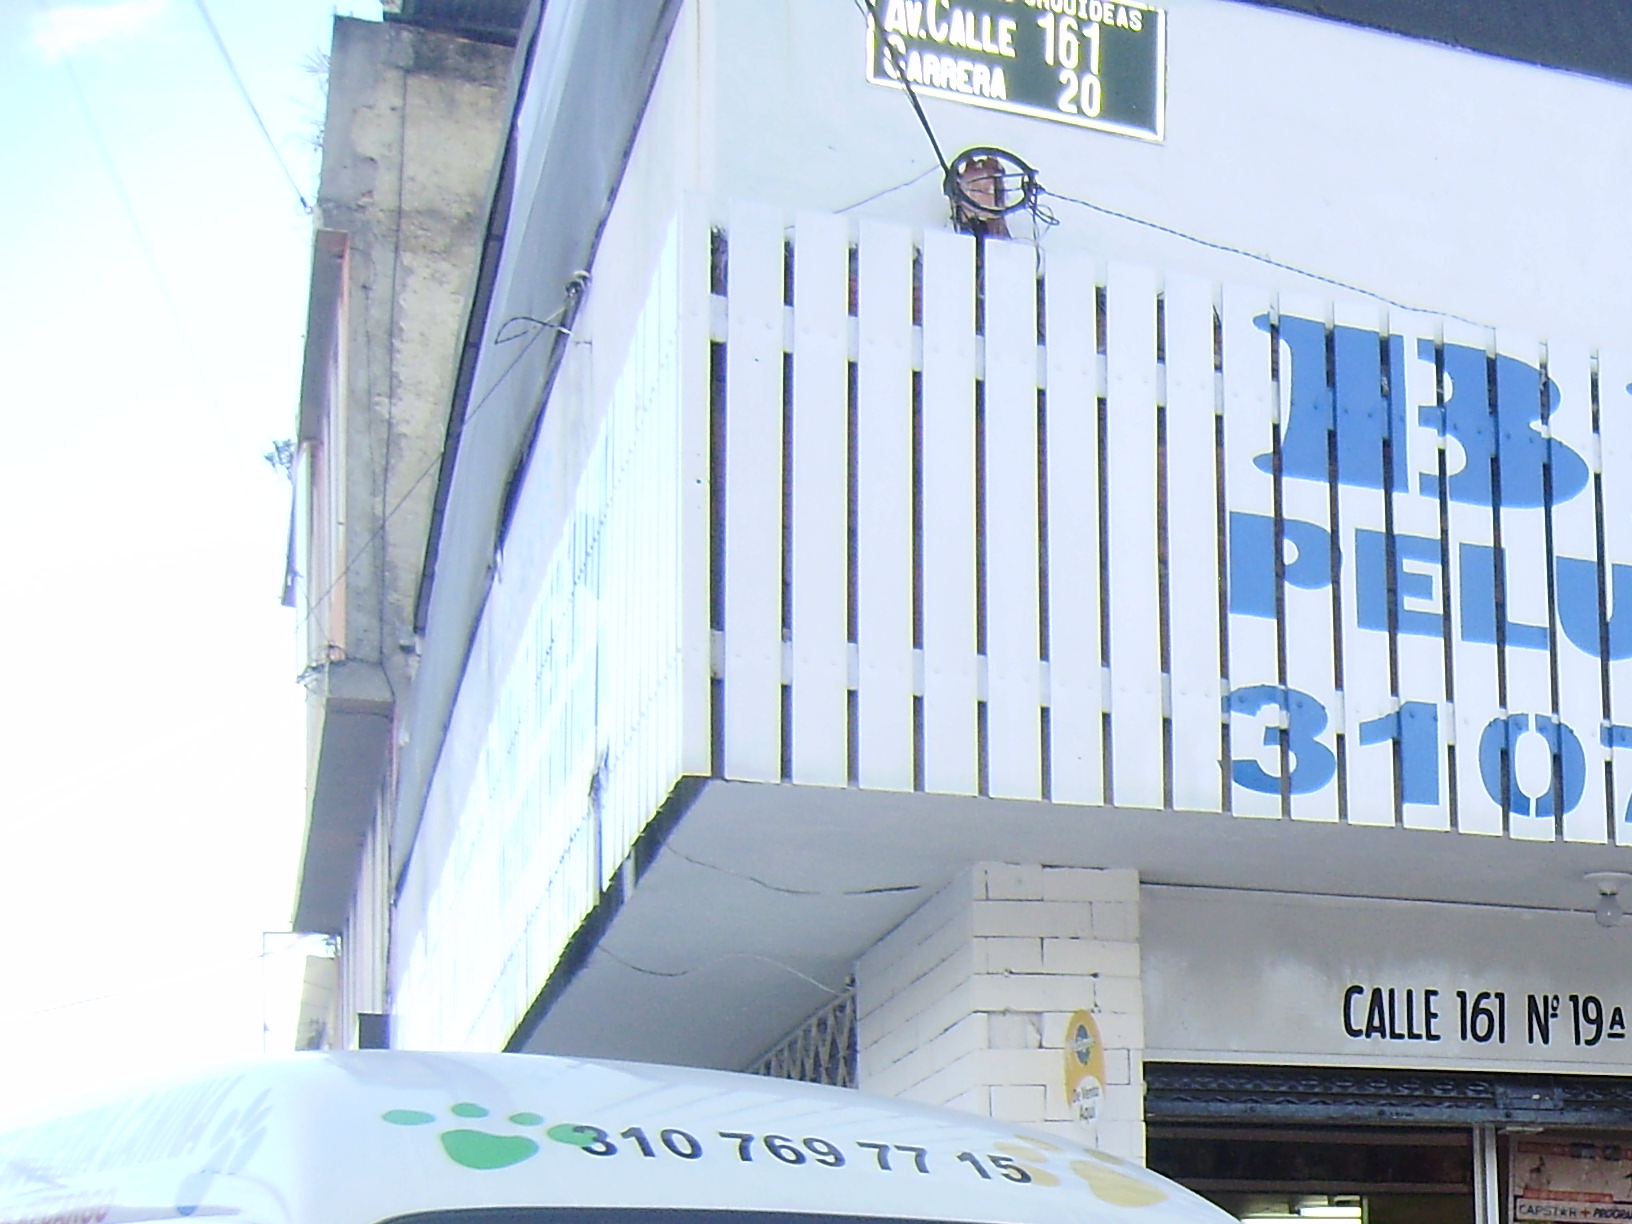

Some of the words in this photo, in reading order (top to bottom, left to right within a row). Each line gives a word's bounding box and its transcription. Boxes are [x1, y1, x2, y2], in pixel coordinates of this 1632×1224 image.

[1037, 11, 1100, 75] 161
[883, 34, 1007, 101] CARRERA
[1058, 67, 1102, 118] 20
[1343, 985, 1441, 1041] CALLE
[1456, 990, 1505, 1044] 161
[572, 1125, 703, 1161] 310
[718, 1130, 847, 1169] 769
[856, 1140, 930, 1174] 77
[956, 1150, 1033, 1185] 15
